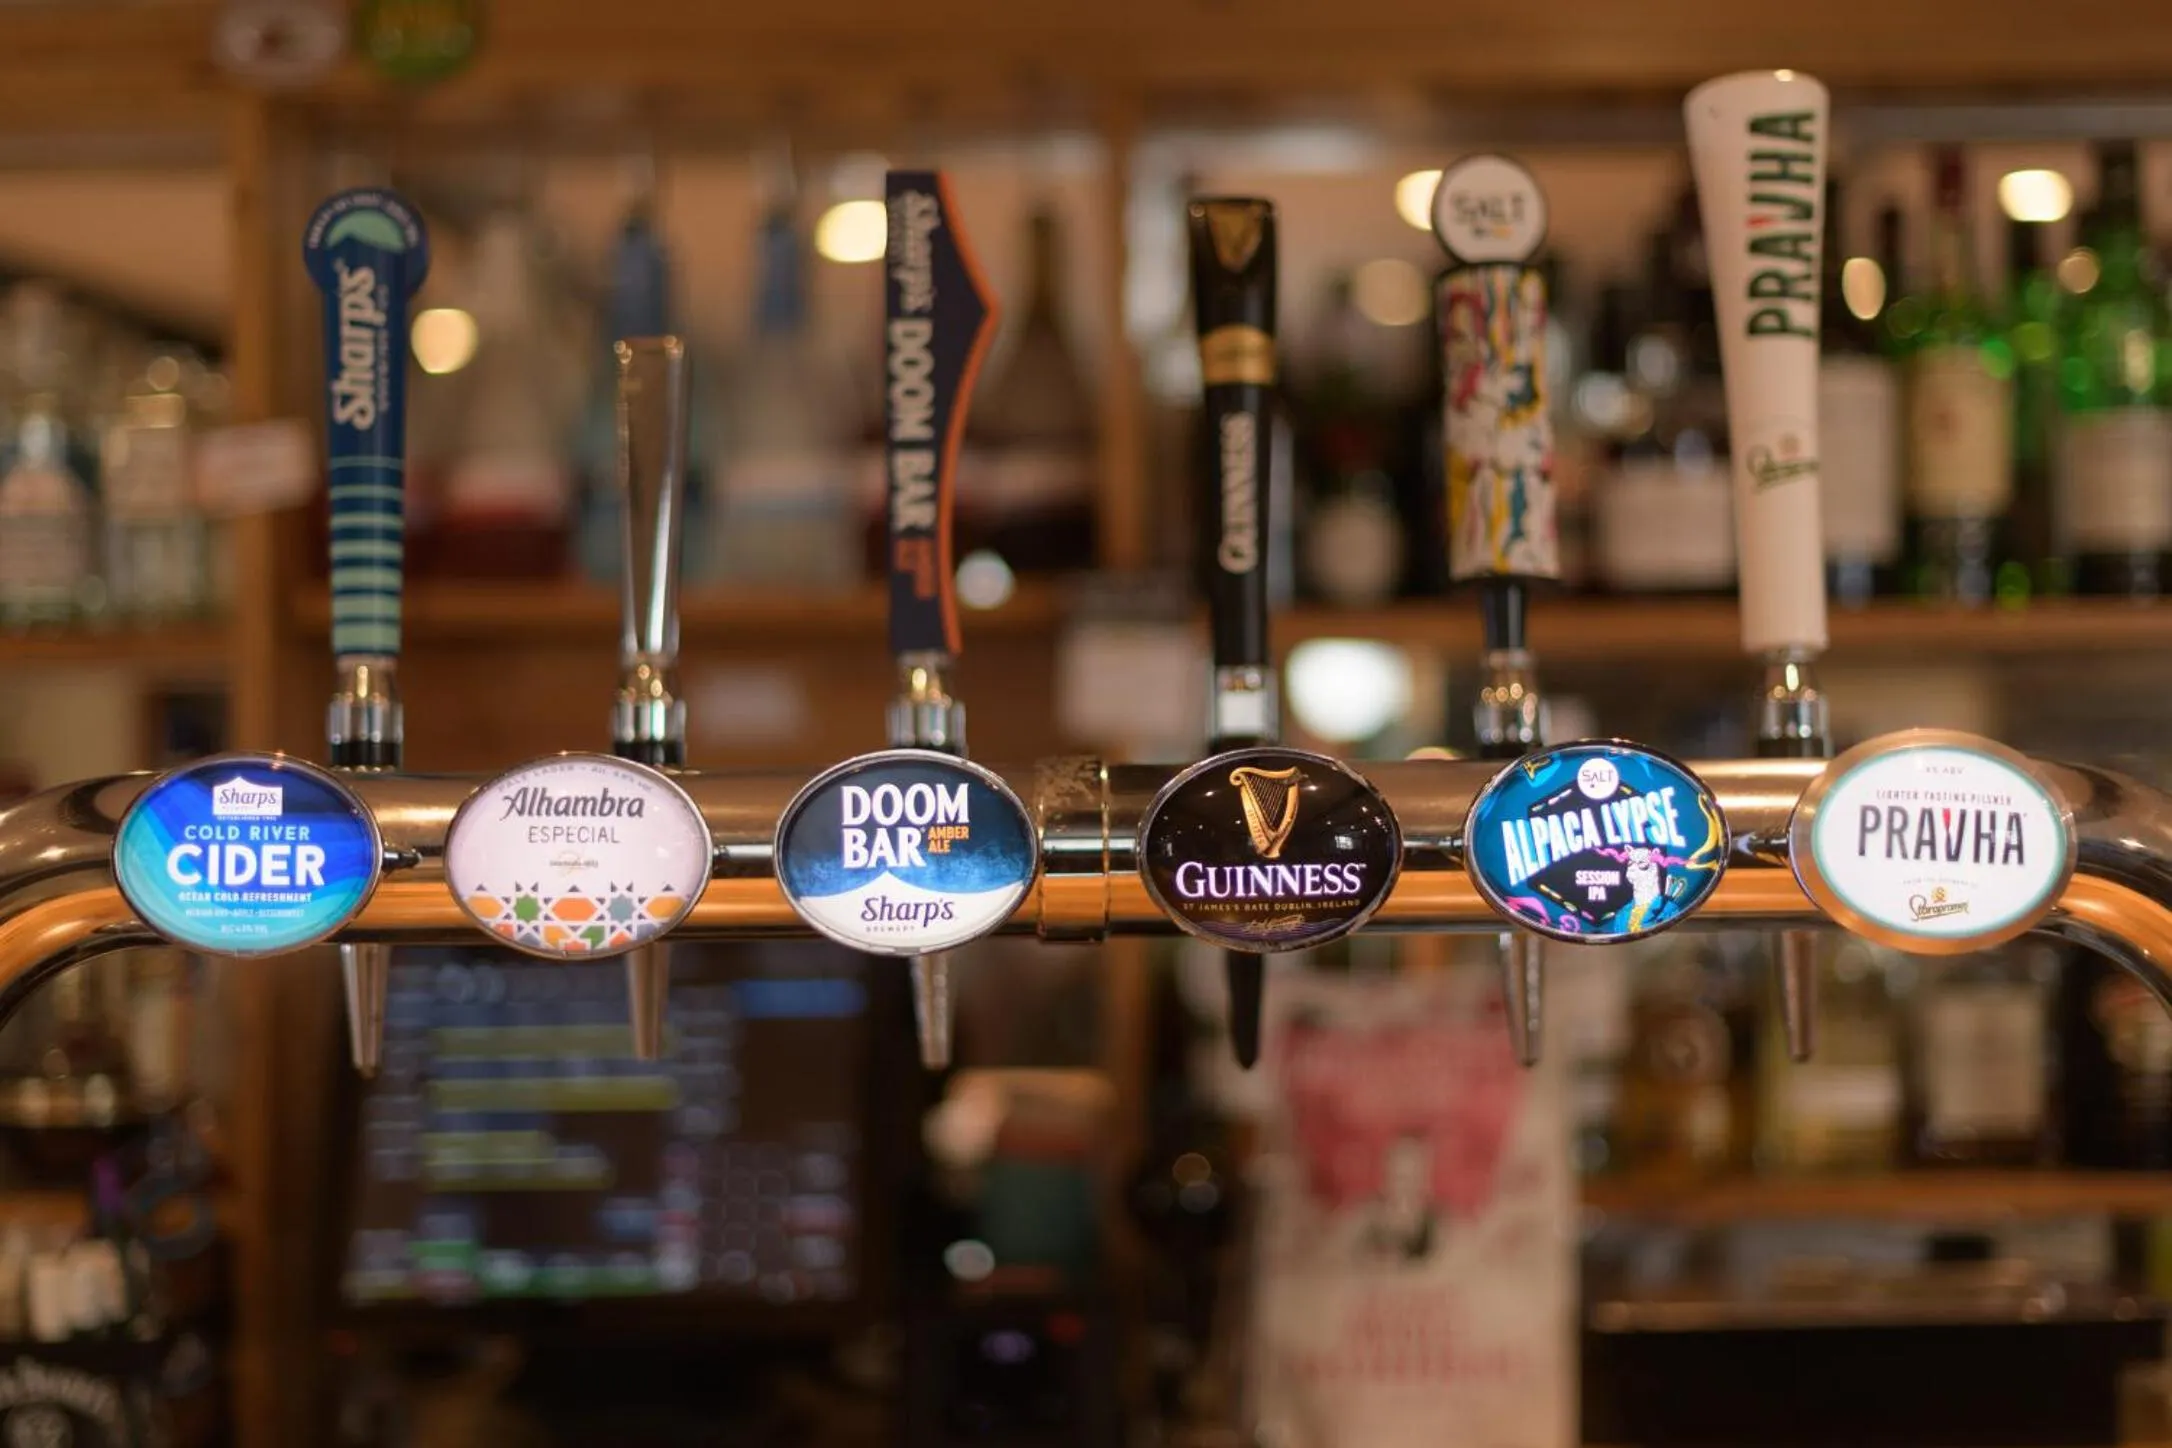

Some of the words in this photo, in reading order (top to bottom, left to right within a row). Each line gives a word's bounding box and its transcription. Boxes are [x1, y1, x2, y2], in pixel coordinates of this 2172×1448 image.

[1747, 112, 1818, 338] PRAVHA
[889, 317, 936, 441] DOOM
[890, 451, 937, 531] BAR
[1582, 769, 1614, 783] SALT
[499, 787, 645, 821] Alhambra
[841, 782, 970, 826] DOOM
[184, 824, 241, 840] COLD
[249, 825, 310, 840] RIVER
[528, 825, 621, 843] ESPECIAL
[843, 827, 928, 869] BAR
[928, 826, 970, 840] AMBER
[928, 840, 951, 853] ALE
[1858, 804, 2024, 866] PRAVHA
[166, 843, 326, 887] CIDER
[1175, 861, 1362, 898] GUINNESS
[1575, 870, 1621, 885] SESSION
[214, 892, 239, 902] COLD
[242, 892, 312, 903] REFRESHMENT
[1588, 886, 1606, 900] IPA
[860, 895, 955, 928] Sharp's
